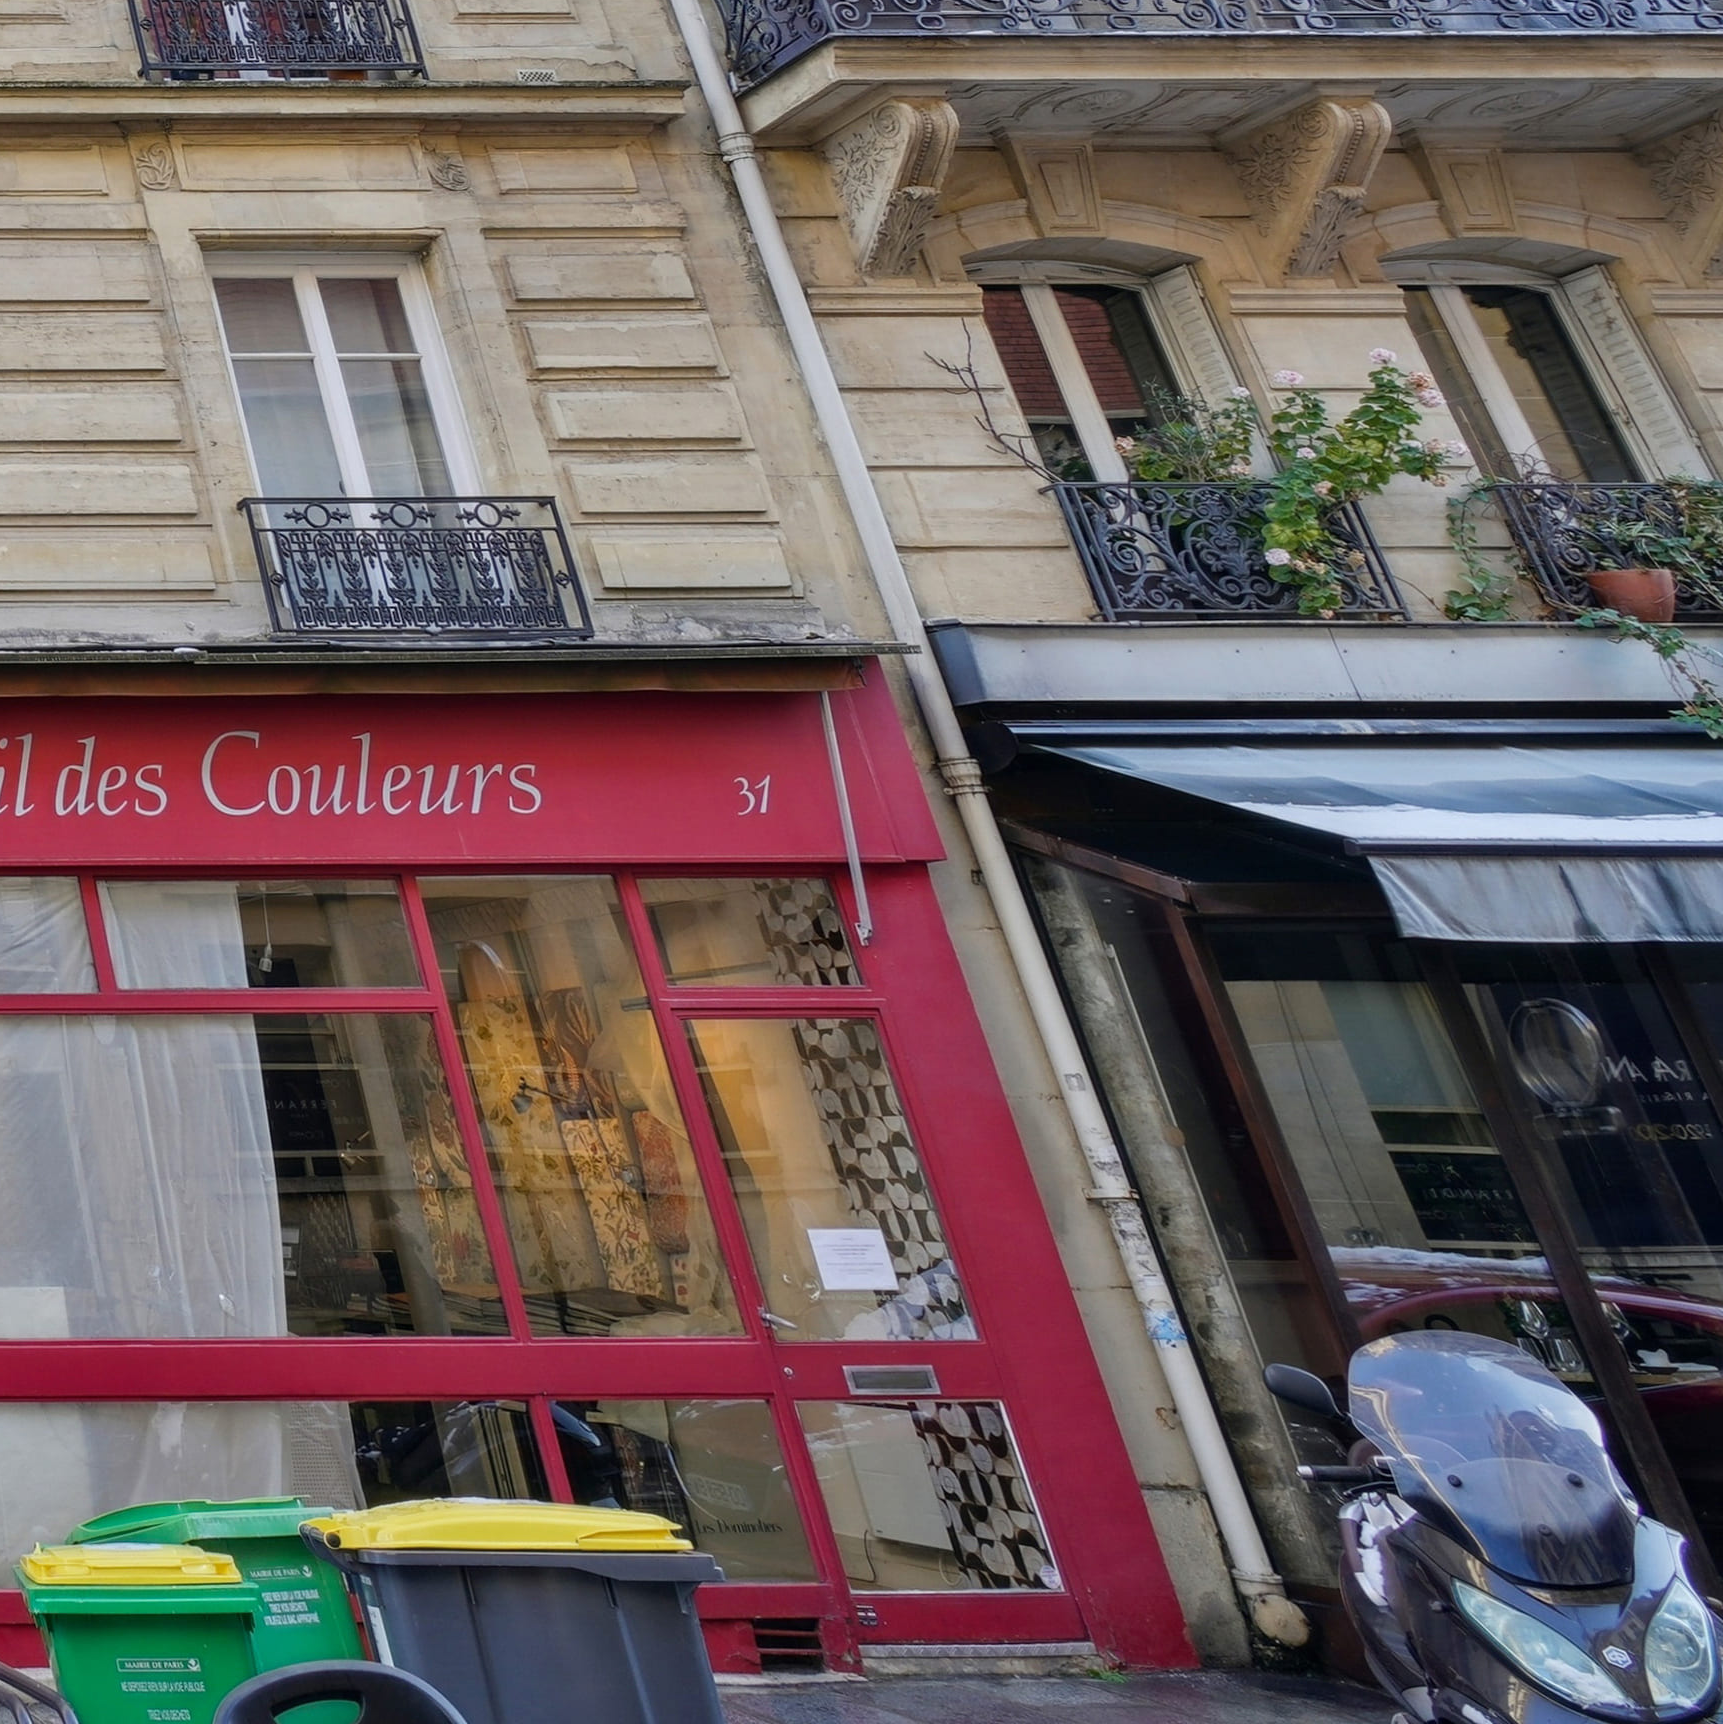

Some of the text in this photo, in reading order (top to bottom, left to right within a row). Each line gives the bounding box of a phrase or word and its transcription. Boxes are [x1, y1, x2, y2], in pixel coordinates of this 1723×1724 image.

[55, 736, 168, 816] des
[201, 734, 542, 816] Couleurs
[734, 775, 772, 816] 31
[273, 1569, 282, 1577] DE
[124, 1661, 184, 1669] MAIRIE DE PARIS
